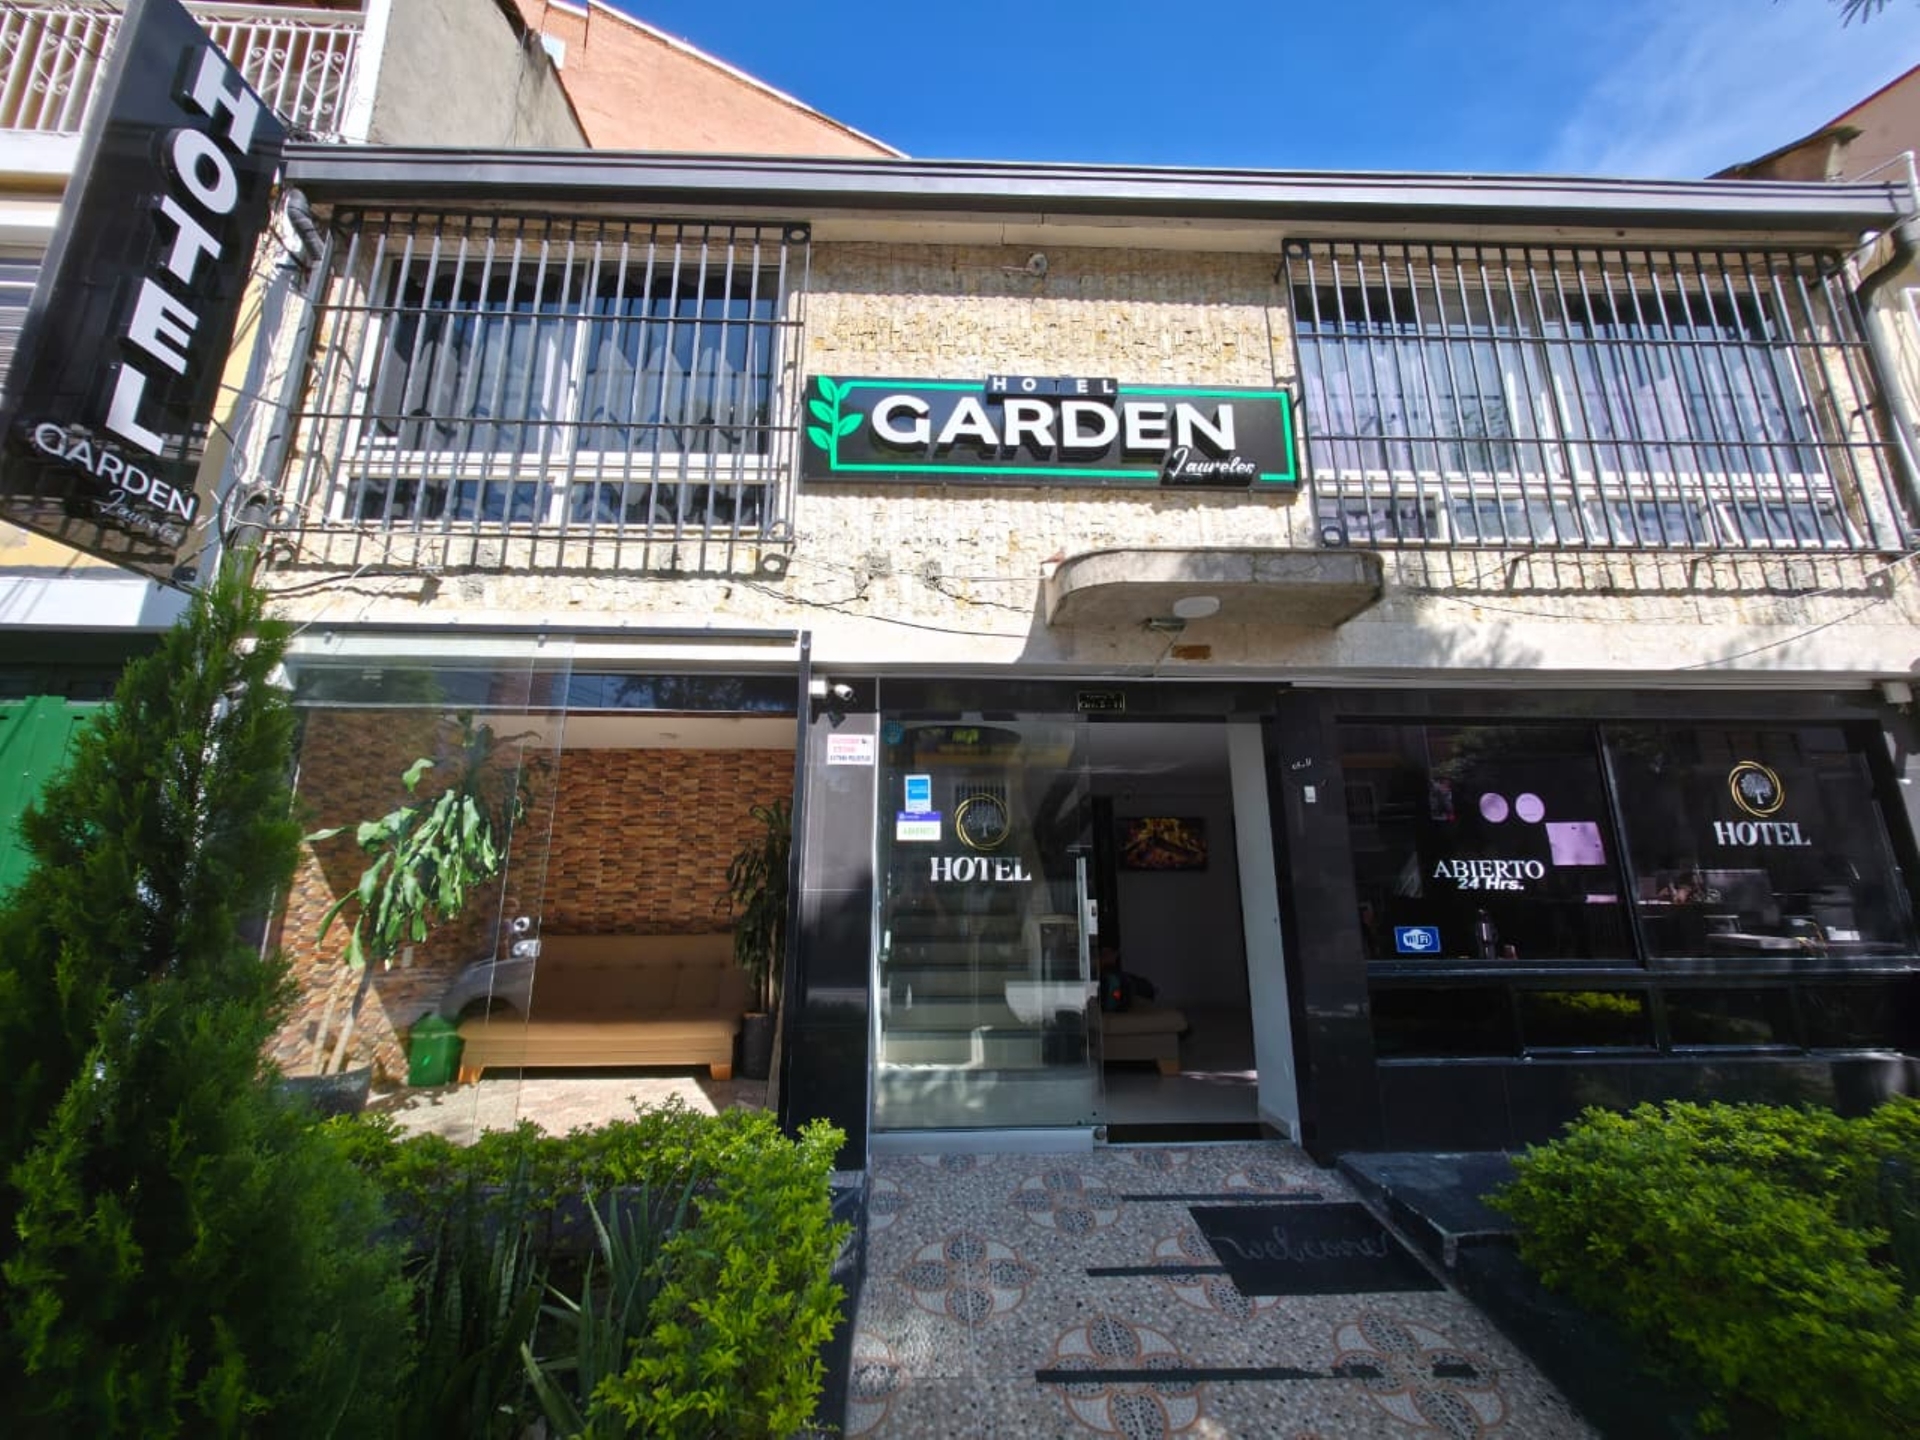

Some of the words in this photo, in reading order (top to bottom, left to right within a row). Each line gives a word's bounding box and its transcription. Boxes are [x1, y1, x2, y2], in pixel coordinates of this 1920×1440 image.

[107, 45, 259, 456] HOTEL
[992, 377, 1115, 394] HOTEL
[871, 395, 1237, 451] GARDEN
[35, 422, 195, 521] GARDEN
[1714, 821, 1811, 846] HOTEL
[930, 857, 1032, 882] HOTEL
[1433, 860, 1544, 879] ABIERTO
[1458, 877, 1479, 890] 24
[1485, 877, 1524, 891] Hrs.
